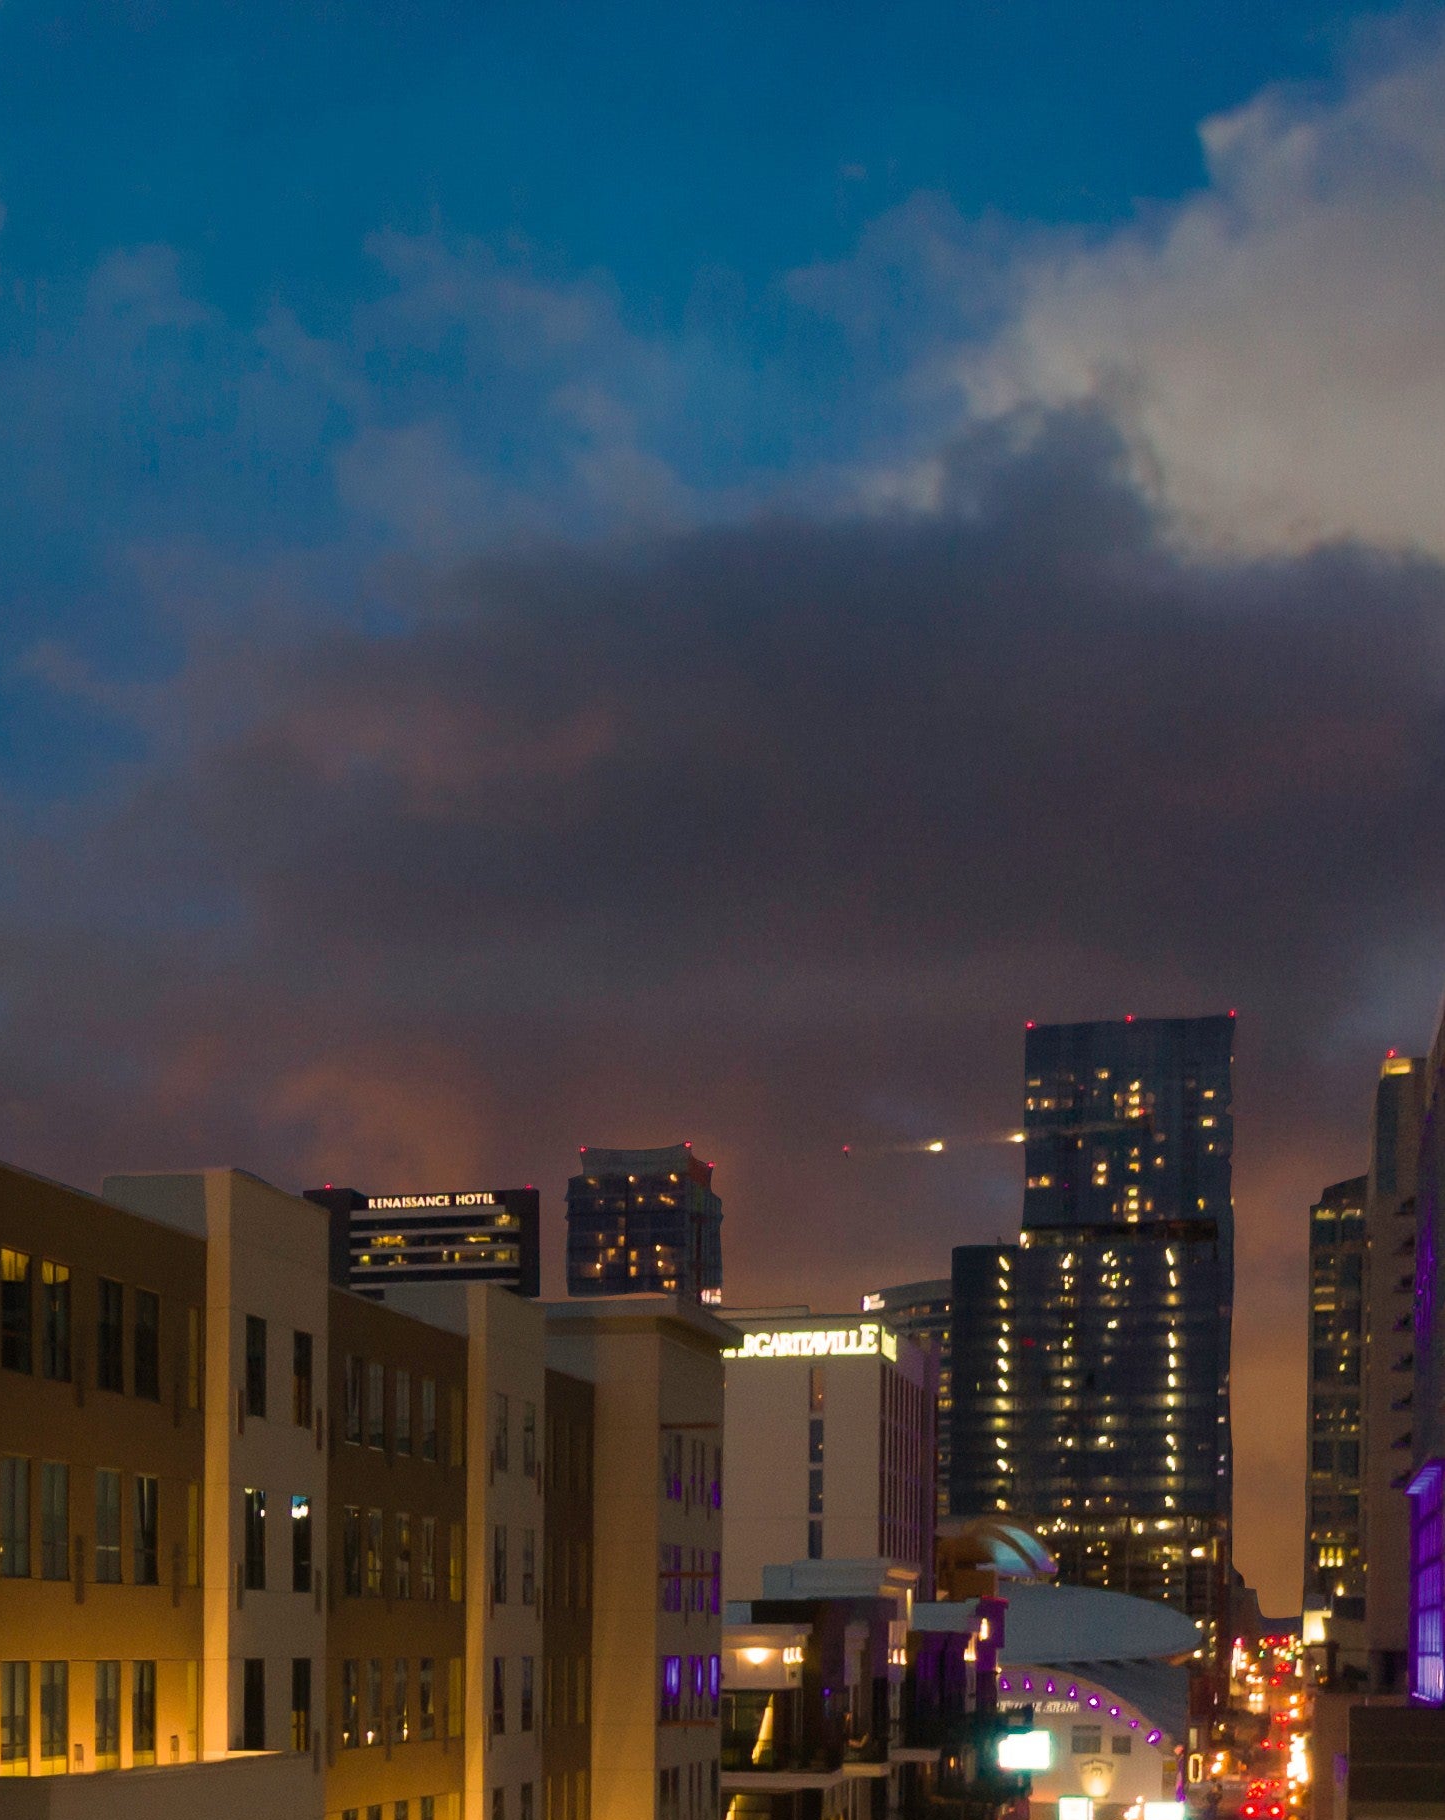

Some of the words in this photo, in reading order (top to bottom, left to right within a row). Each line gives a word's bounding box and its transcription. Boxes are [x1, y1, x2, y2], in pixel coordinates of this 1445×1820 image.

[368, 1195, 450, 1209] RENAISSANCE
[455, 1193, 495, 1206] HOTEL
[719, 1323, 879, 1358] RGARITAVILLE
